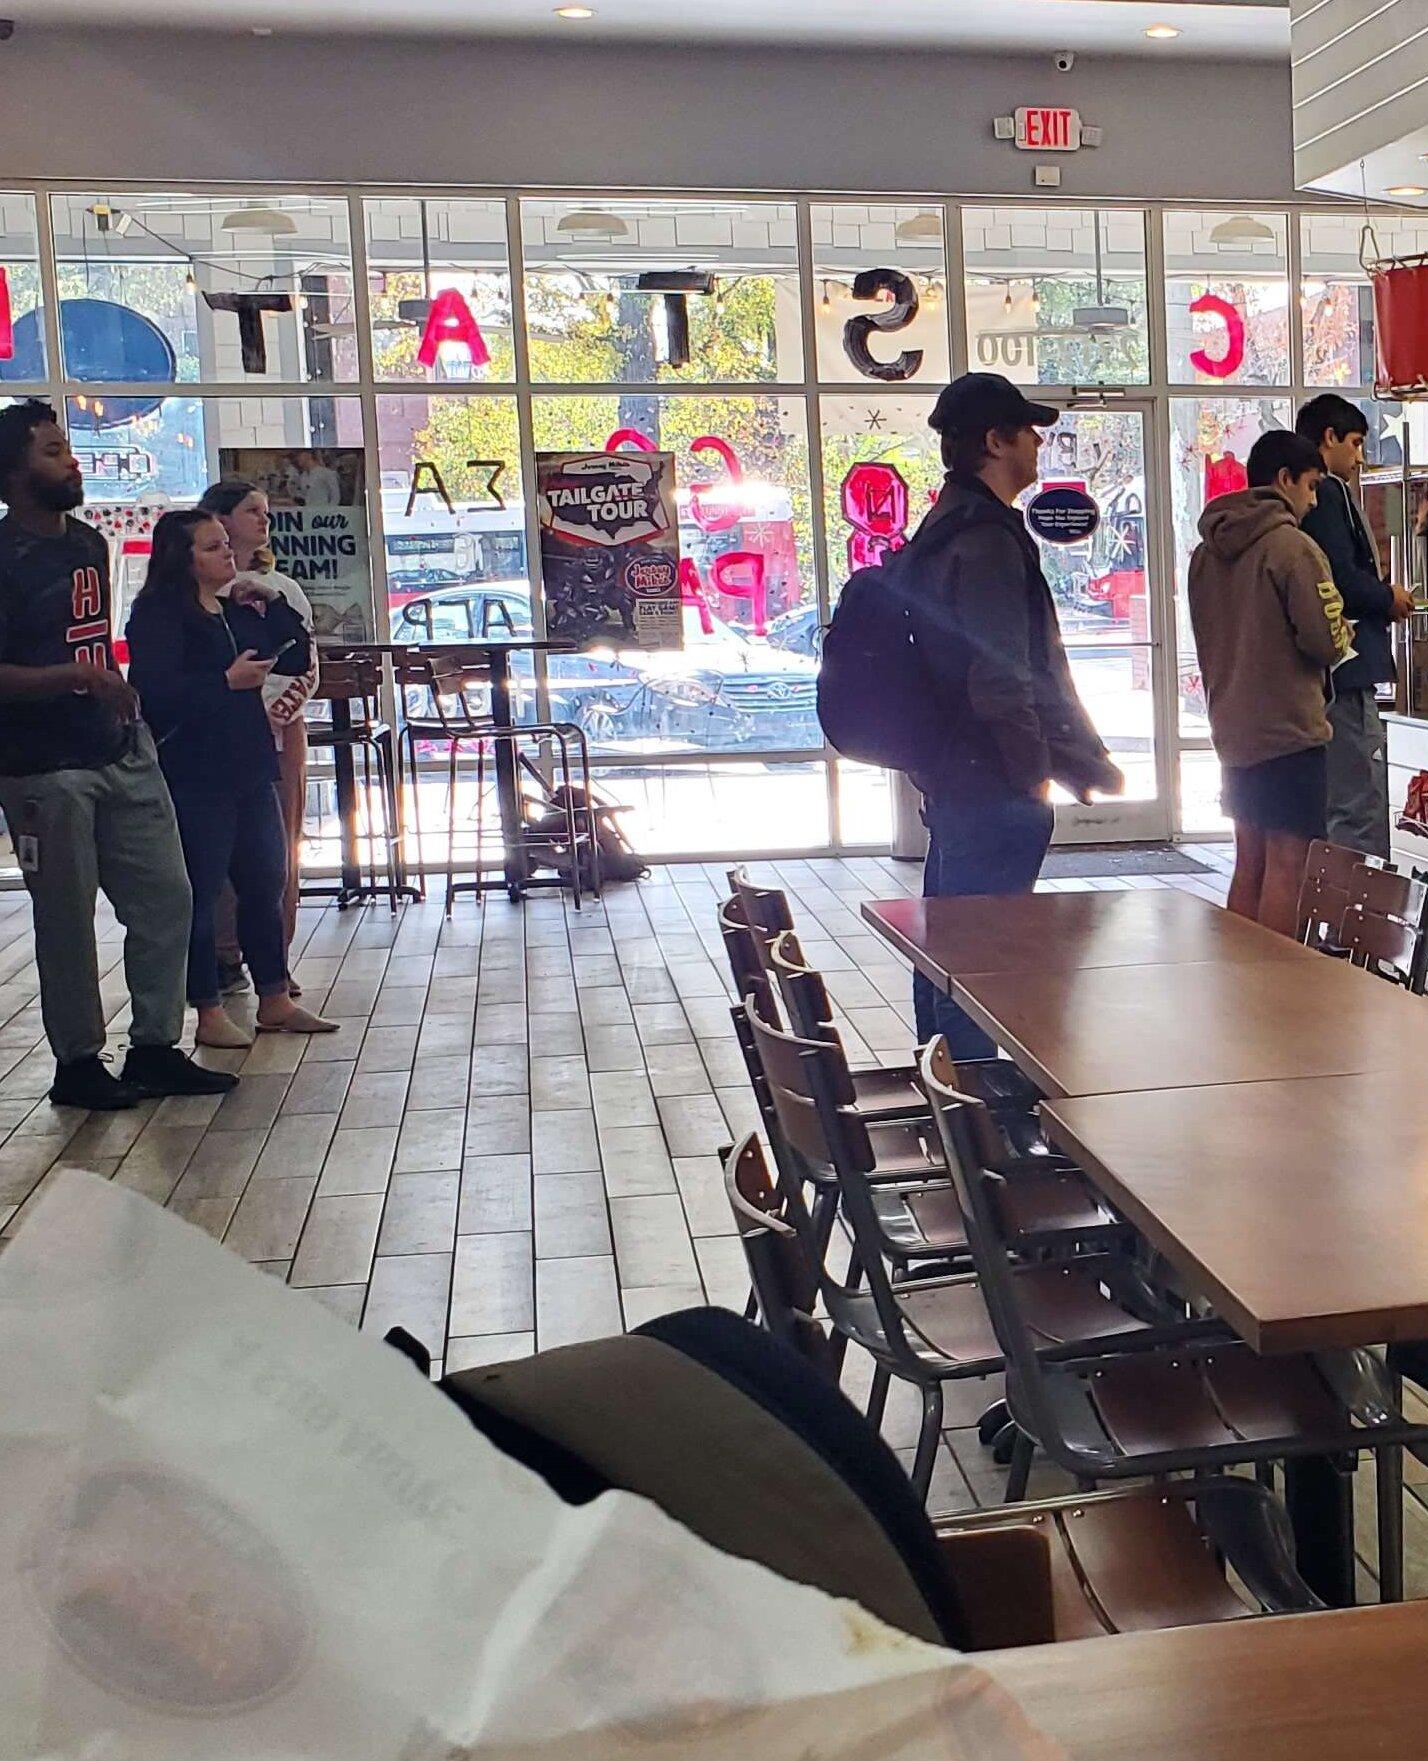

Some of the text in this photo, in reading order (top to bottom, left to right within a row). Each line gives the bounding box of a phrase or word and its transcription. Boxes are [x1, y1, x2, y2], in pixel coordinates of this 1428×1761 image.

[1026, 110, 1071, 147] EXIT
[547, 482, 644, 507] TAILGATE
[311, 513, 348, 530] our
[586, 500, 648, 522] TOUR
[270, 534, 356, 556] NNING
[276, 559, 338, 580] EAM!
